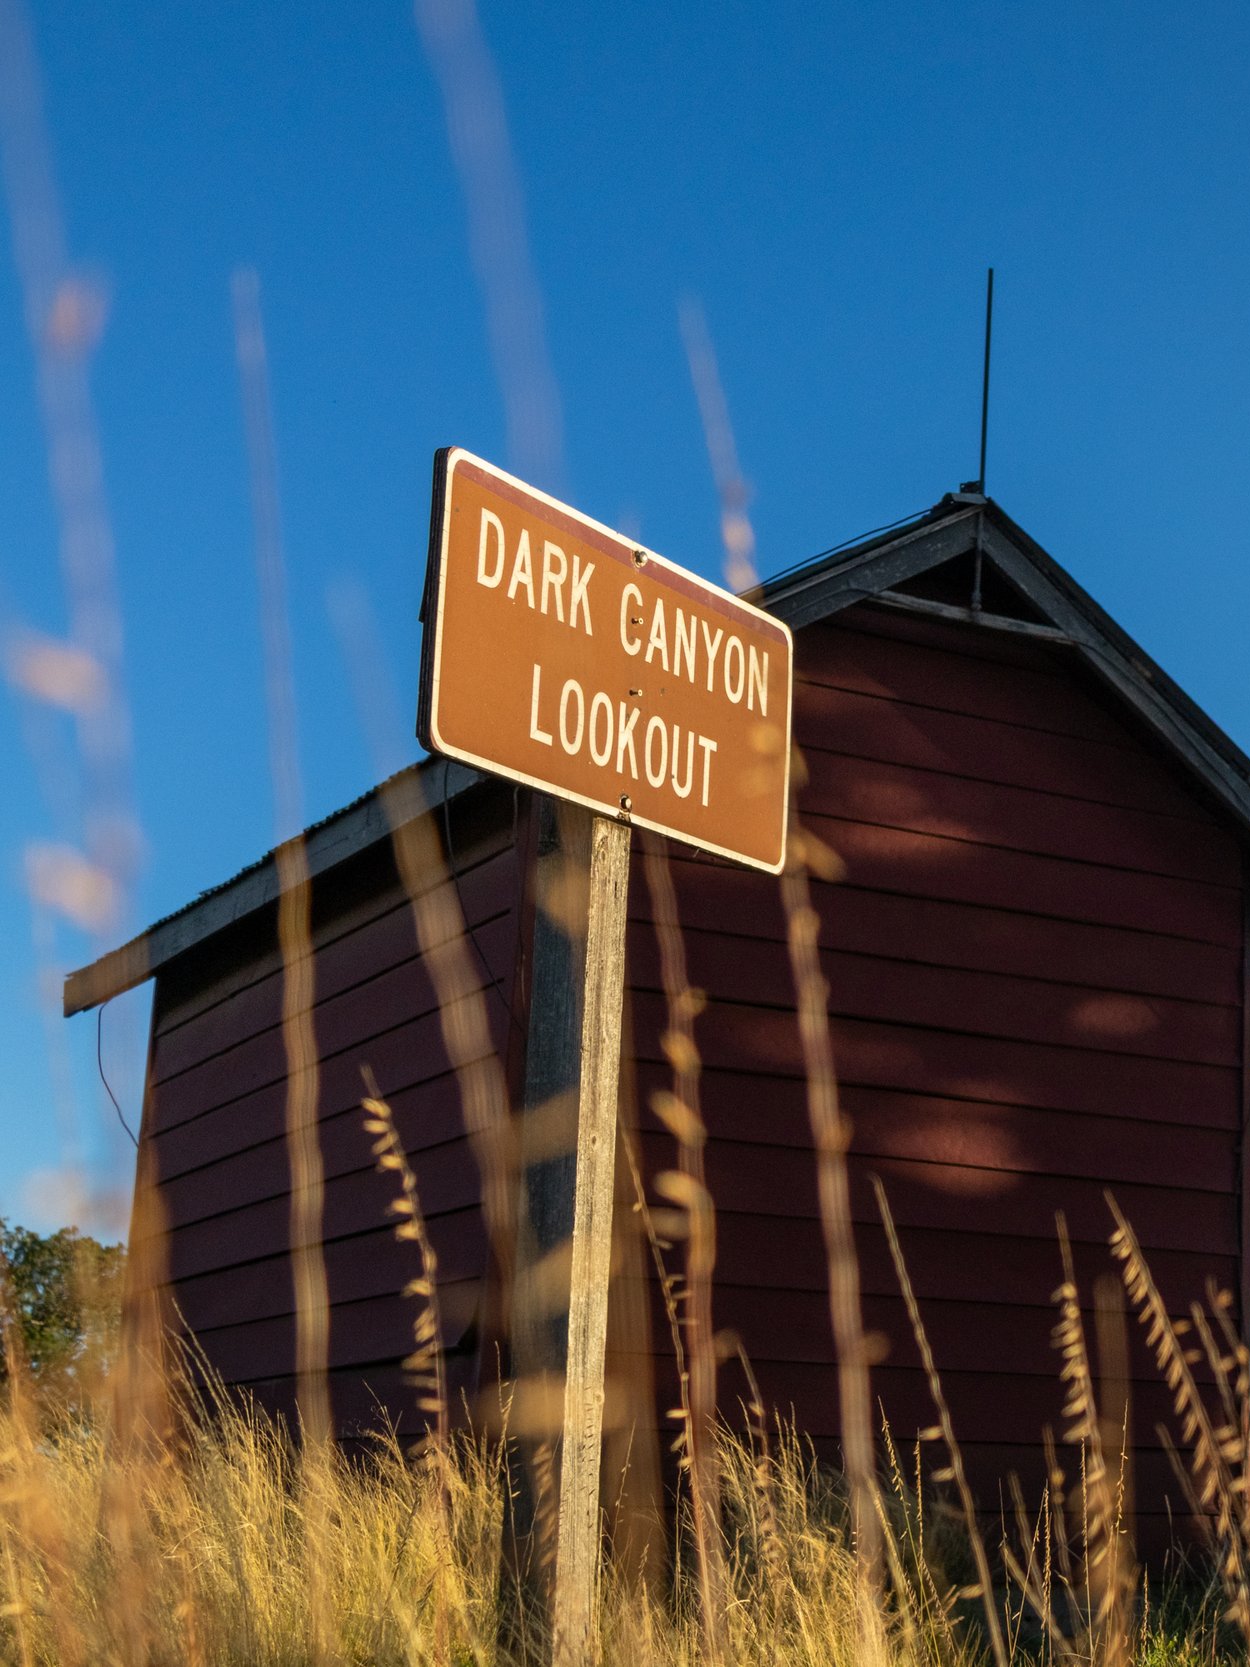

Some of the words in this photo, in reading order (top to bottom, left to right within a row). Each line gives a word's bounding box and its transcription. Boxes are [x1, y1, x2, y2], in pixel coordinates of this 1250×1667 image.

[476, 507, 596, 637] DARK
[619, 582, 769, 717] CANYON
[529, 663, 718, 807] LOOKOUT
